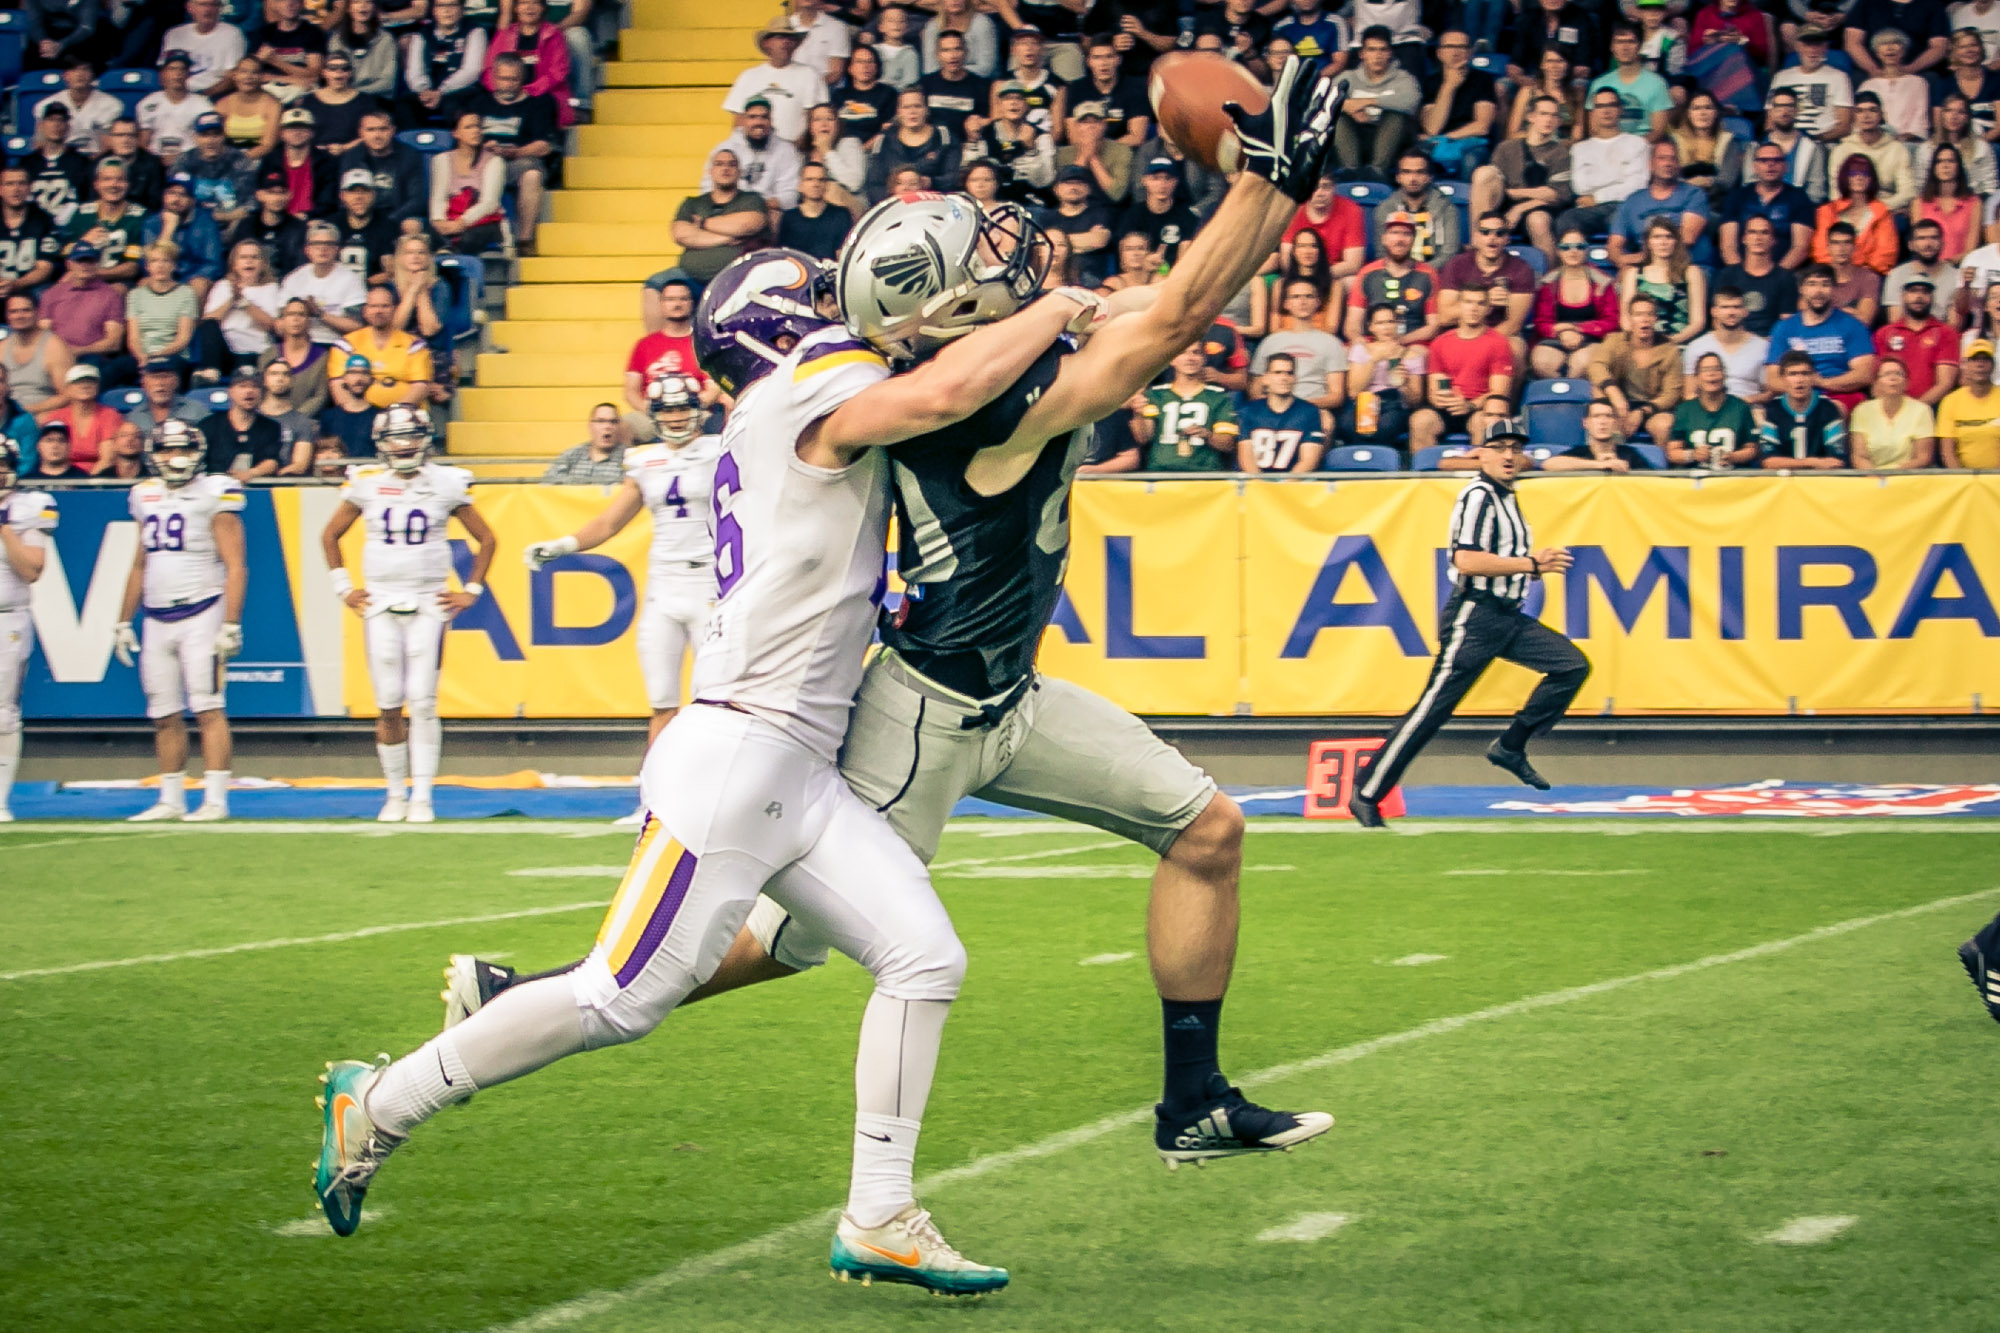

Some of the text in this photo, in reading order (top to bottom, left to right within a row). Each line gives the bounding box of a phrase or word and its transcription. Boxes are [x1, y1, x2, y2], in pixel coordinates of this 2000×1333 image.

[1159, 402, 1209, 446] 12
[1790, 427, 1808, 459] 1
[1251, 429, 1303, 469] 87
[666, 475, 688, 518] 4
[382, 507, 428, 545] 10
[1279, 534, 2000, 659] AMIRA
